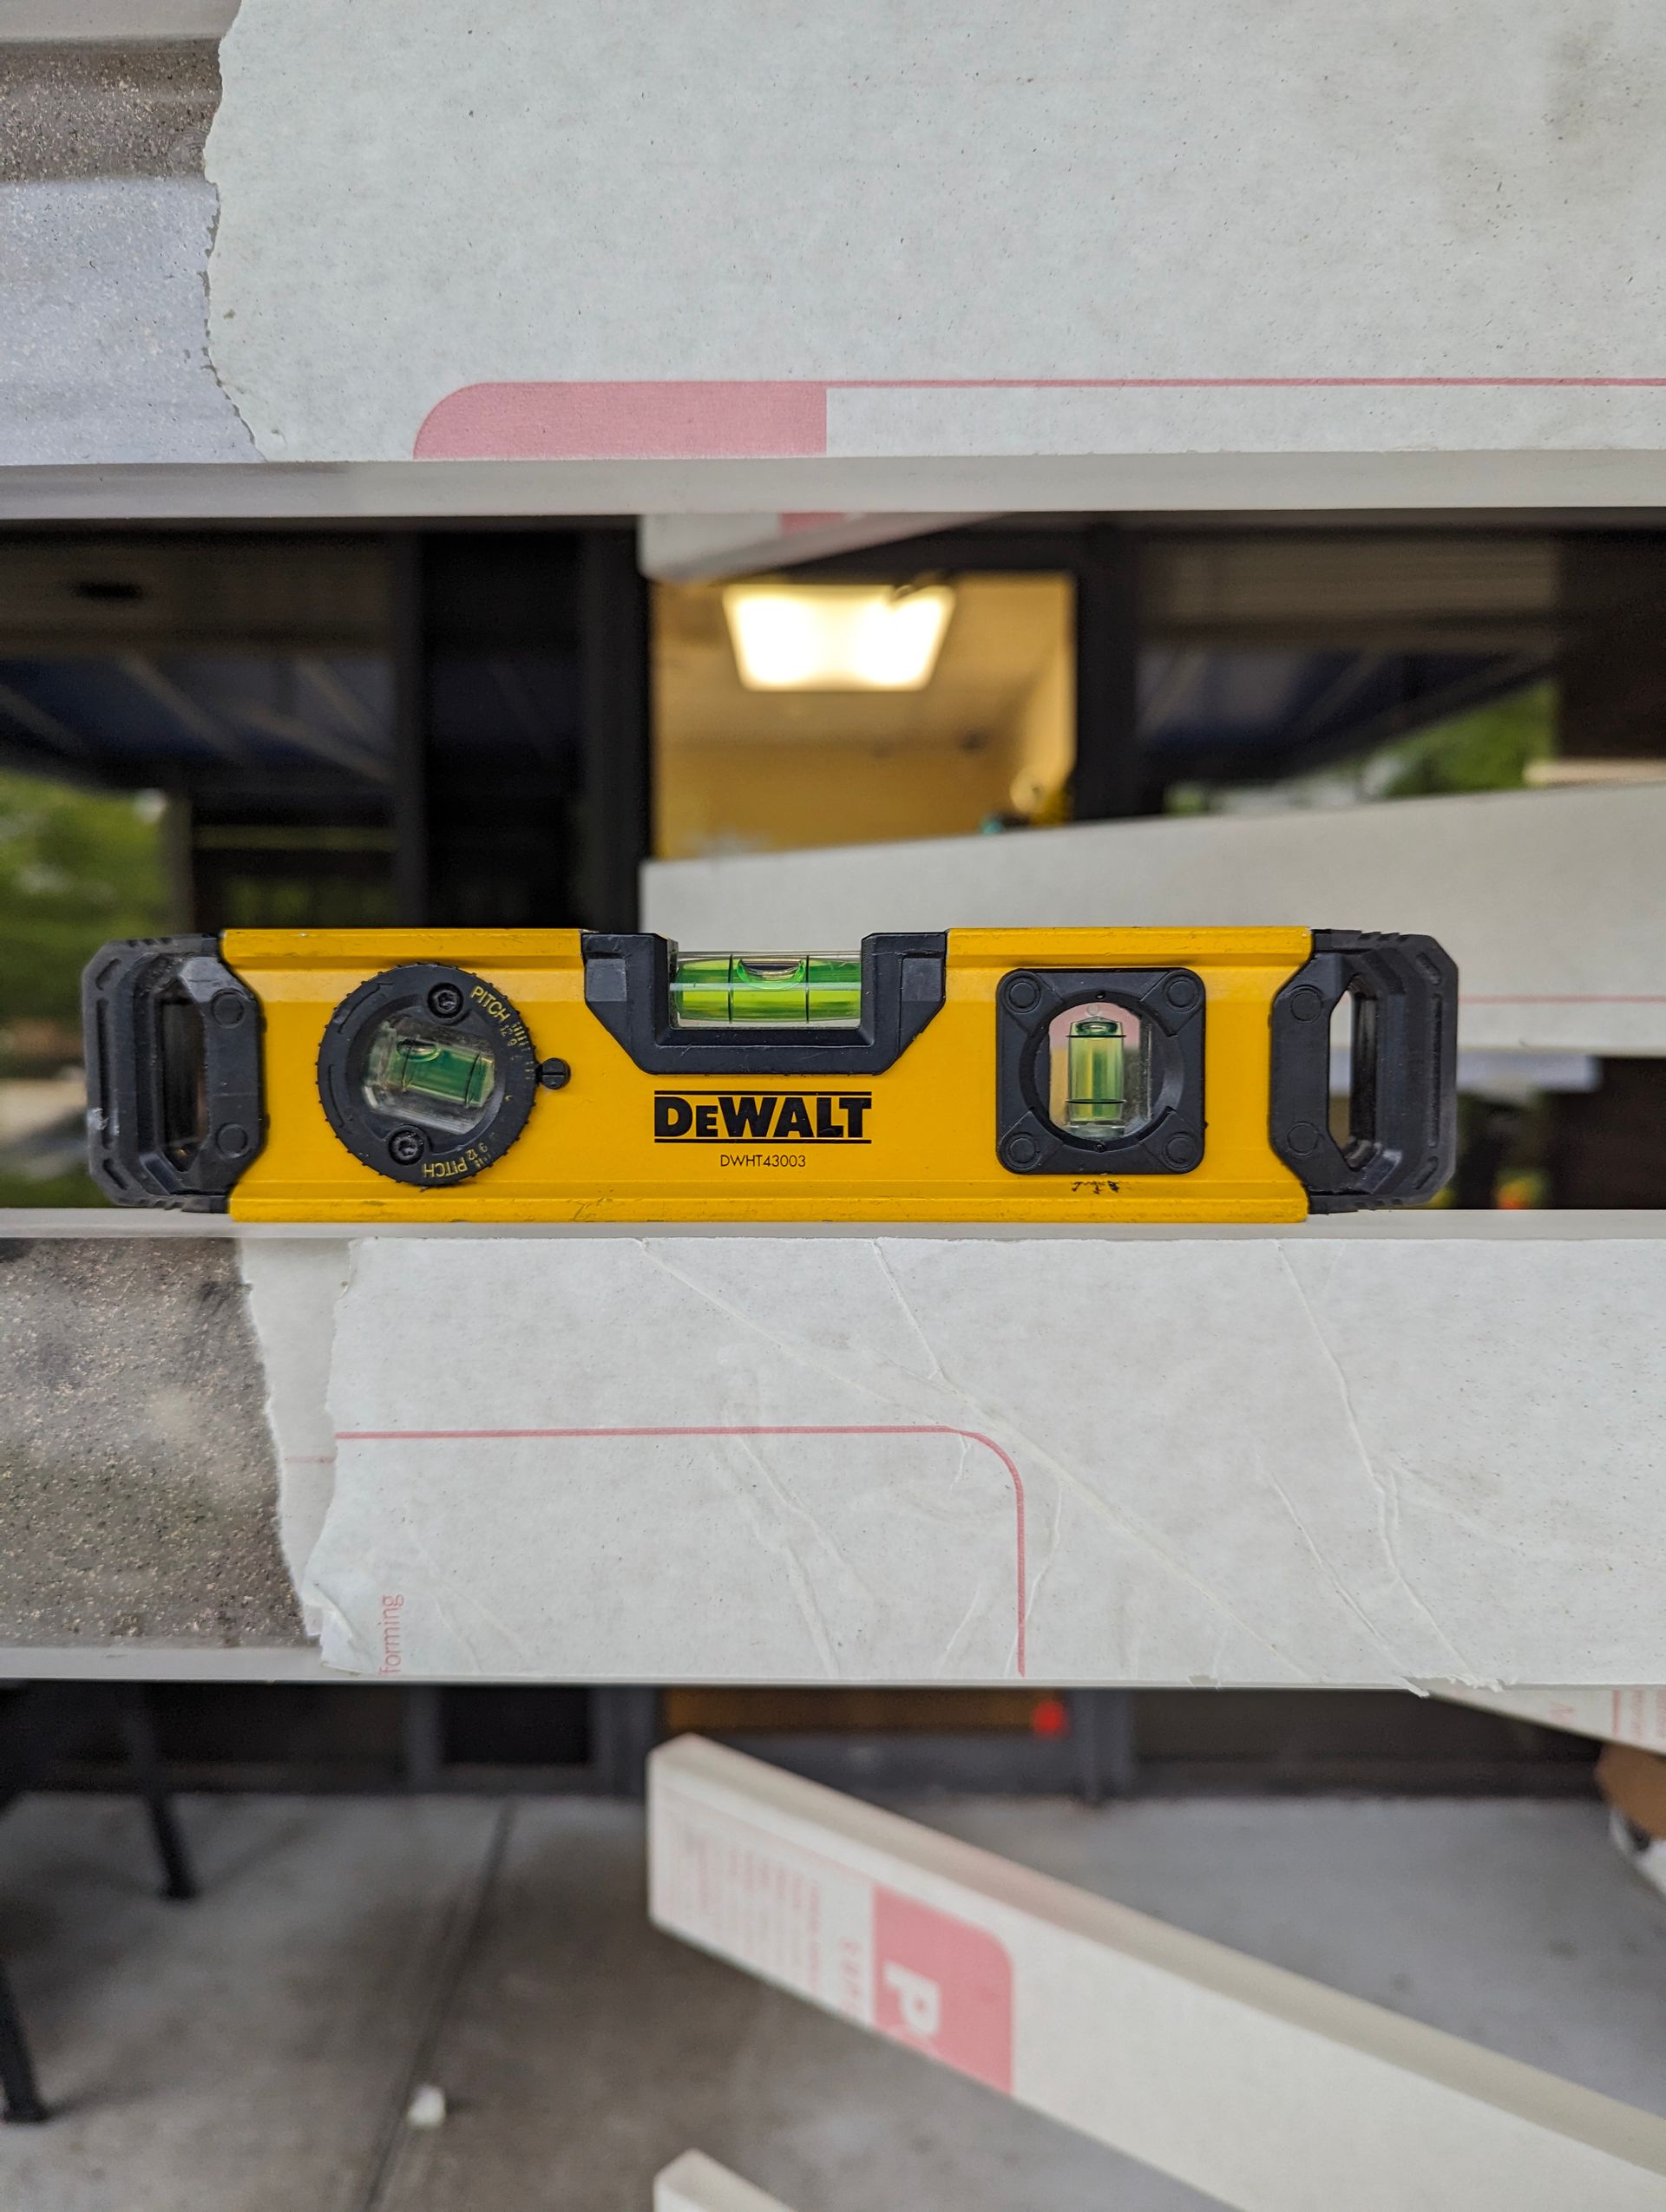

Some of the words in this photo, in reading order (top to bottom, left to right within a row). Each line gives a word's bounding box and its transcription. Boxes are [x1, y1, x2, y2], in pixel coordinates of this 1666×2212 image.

[470, 985, 510, 1022] PITCH
[653, 1096, 872, 1138] DEWALT
[423, 1157, 469, 1178] PITCH
[719, 1154, 807, 1168] DWHT43003
[380, 1594, 403, 1675] forming
